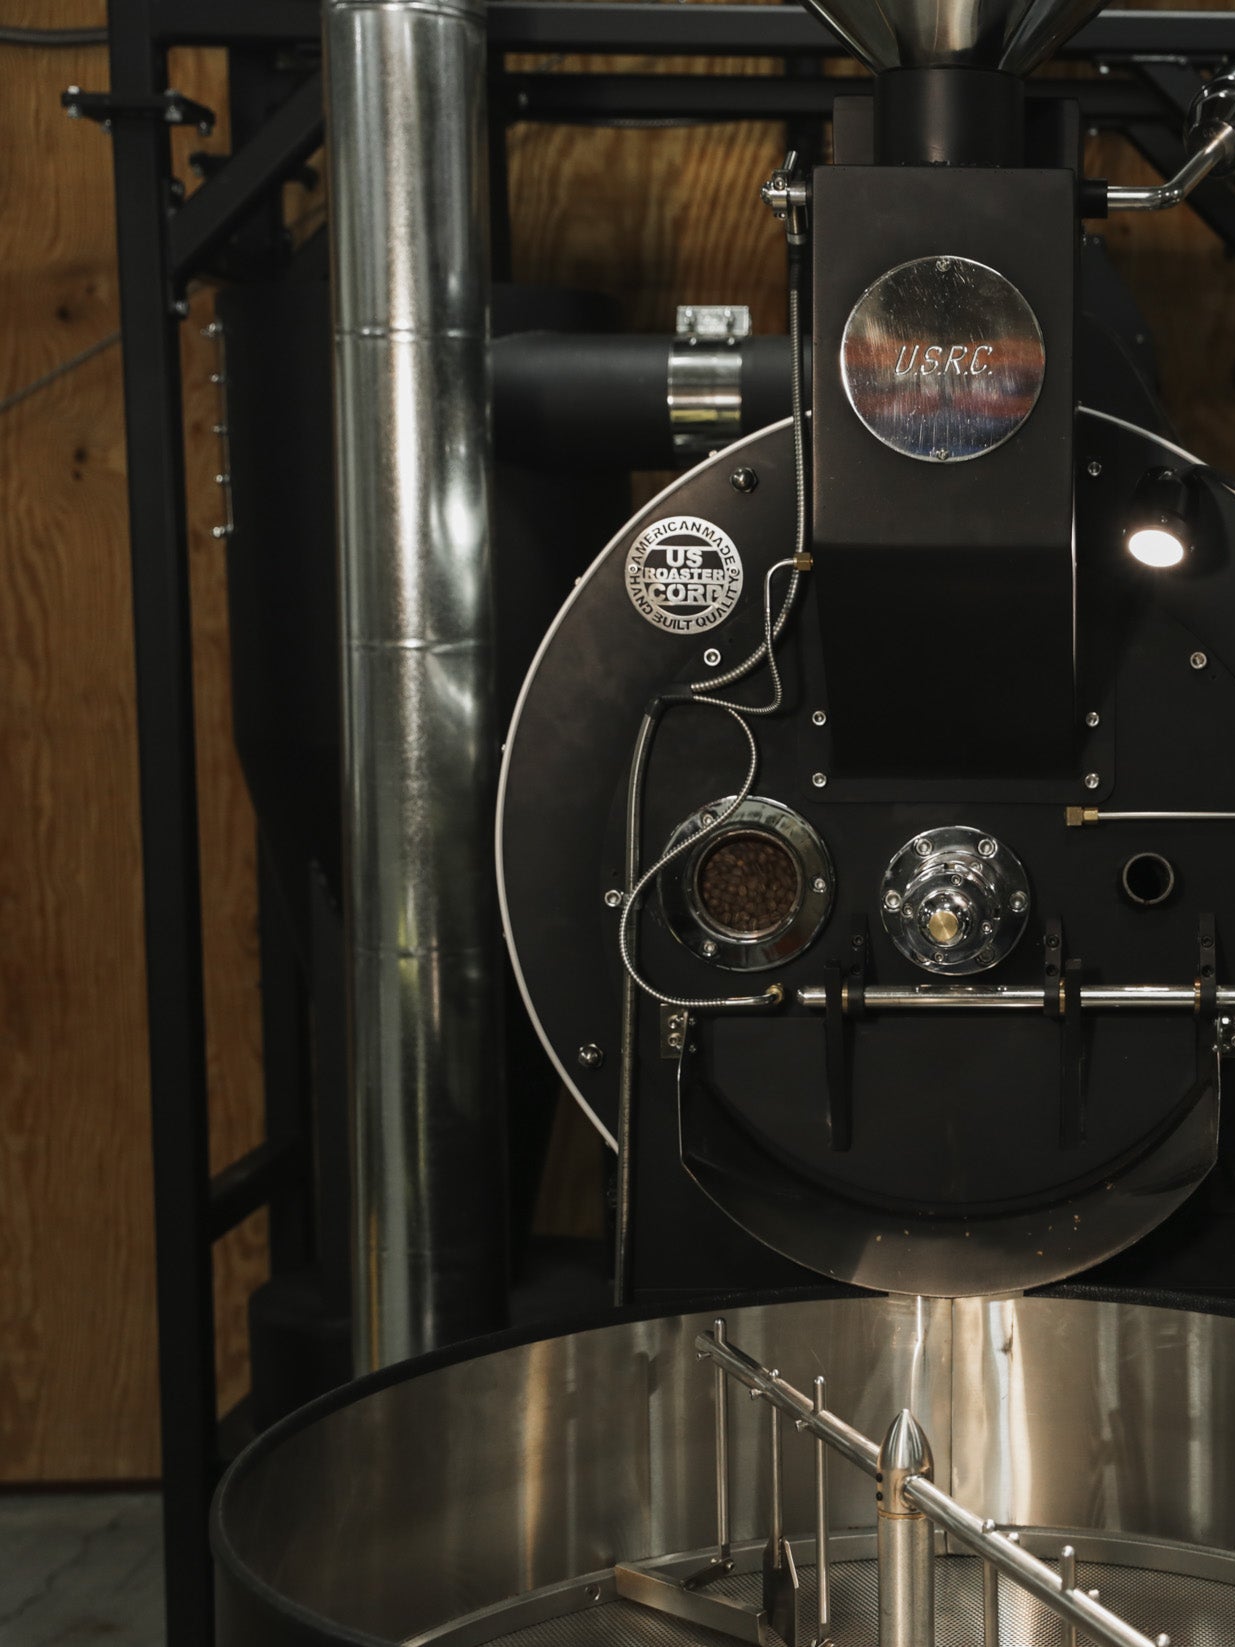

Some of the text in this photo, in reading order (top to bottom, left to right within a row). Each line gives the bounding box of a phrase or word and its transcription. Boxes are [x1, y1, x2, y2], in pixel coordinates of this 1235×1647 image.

[666, 549, 703, 568] US
[644, 567, 724, 582] ROASTER
[648, 583, 723, 602] CORP
[630, 575, 740, 630] HAND BUILT QUALITY
